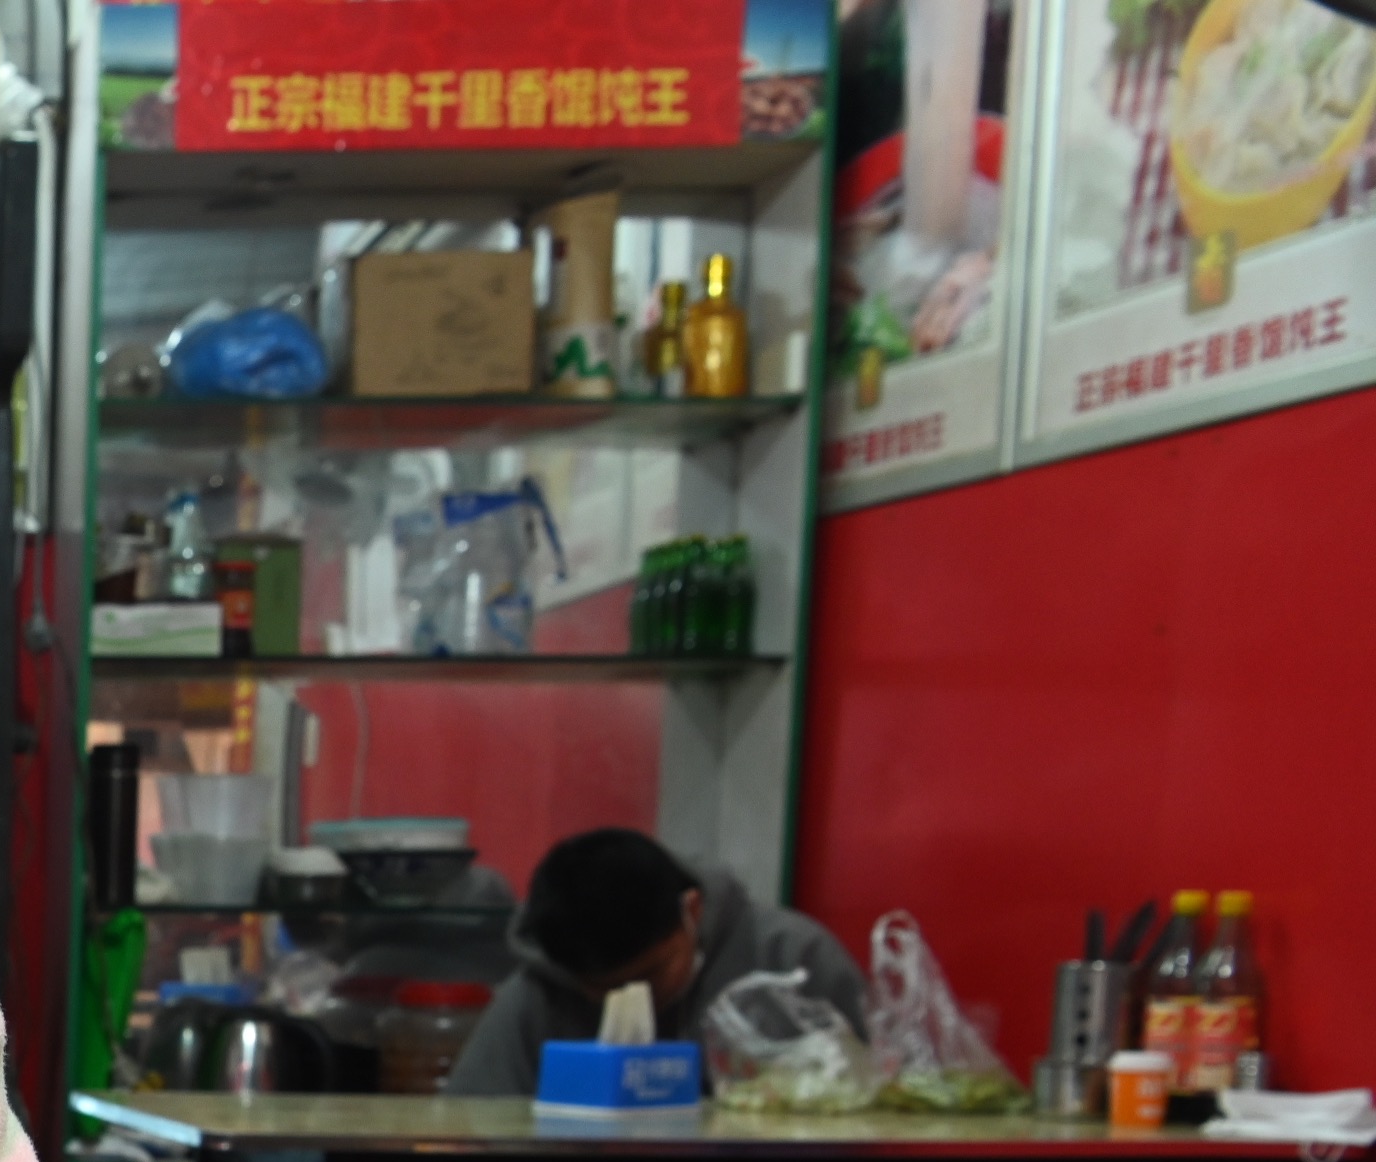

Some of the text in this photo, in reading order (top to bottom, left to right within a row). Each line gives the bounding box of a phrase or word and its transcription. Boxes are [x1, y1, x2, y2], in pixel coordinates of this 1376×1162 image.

[228, 67, 690, 132] 正宗福建千里香馄饨王
